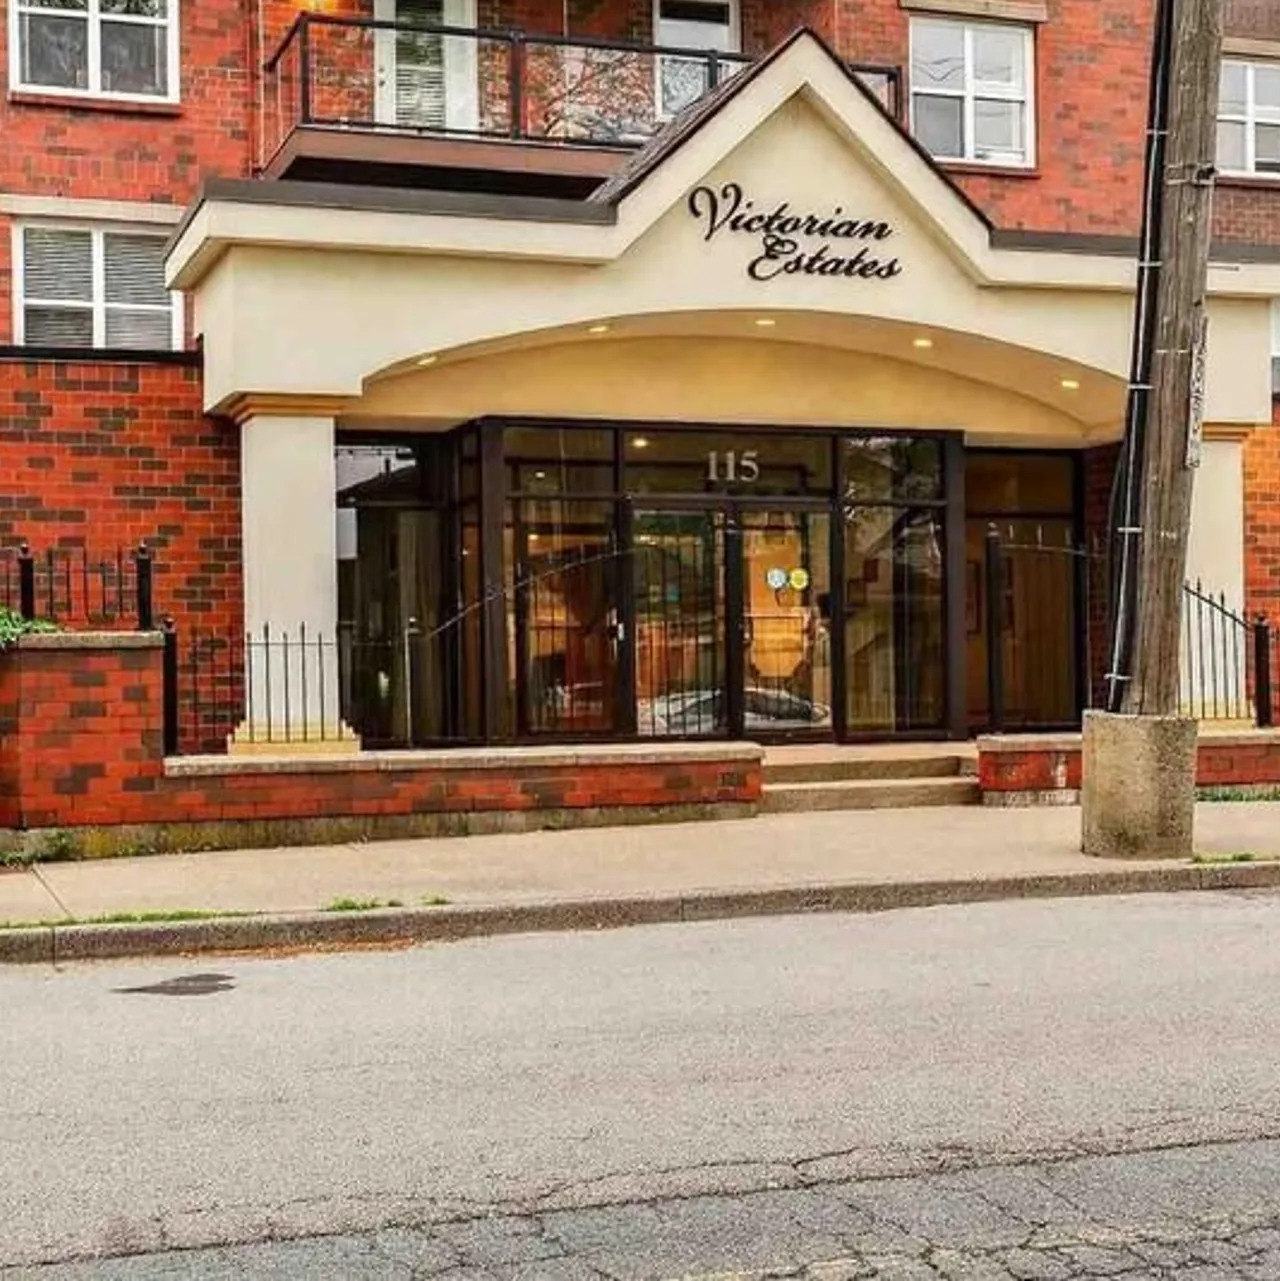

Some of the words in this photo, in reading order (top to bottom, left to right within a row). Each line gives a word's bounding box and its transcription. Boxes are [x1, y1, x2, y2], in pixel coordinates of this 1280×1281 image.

[688, 183, 894, 241] Victorian
[748, 235, 902, 281] Estates
[708, 450, 759, 481] 115
